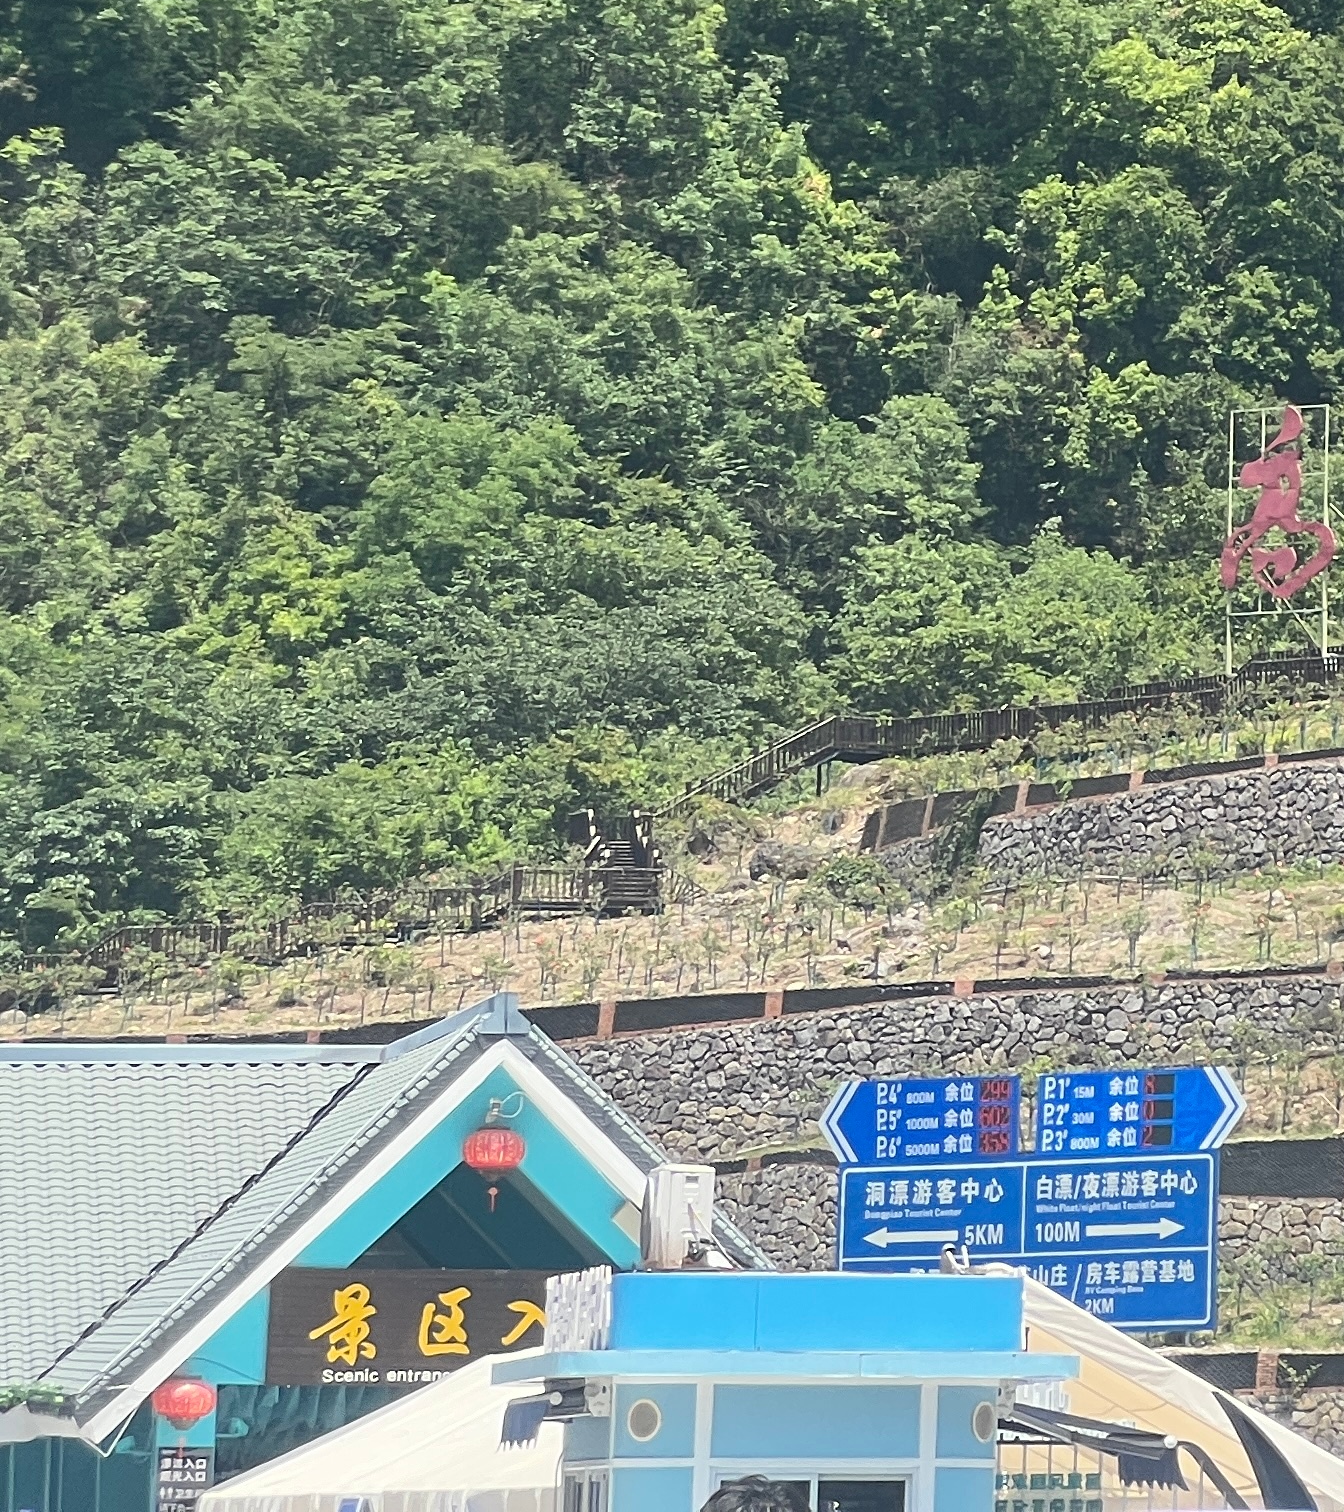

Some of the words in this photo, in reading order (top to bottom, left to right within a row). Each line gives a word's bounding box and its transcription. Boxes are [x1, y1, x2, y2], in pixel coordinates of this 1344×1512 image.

[945, 1082, 974, 1102] 余位
[1109, 1075, 1139, 1096] 余位
[944, 1107, 974, 1128] 余位
[1108, 1101, 1139, 1122] 余位
[943, 1133, 973, 1154] 余位
[1106, 1126, 1137, 1148] 余位
[865, 1177, 1004, 1207] 洞漂游客中心
[1036, 1168, 1198, 1201] 白漂/夜漂游客中心
[965, 1223, 1003, 1246] 5KM
[1036, 1221, 1080, 1243] 100M
[1085, 1259, 1195, 1286] 房车露营基地
[1085, 1297, 1114, 1314] 2KM
[322, 1368, 379, 1383] Scenic
